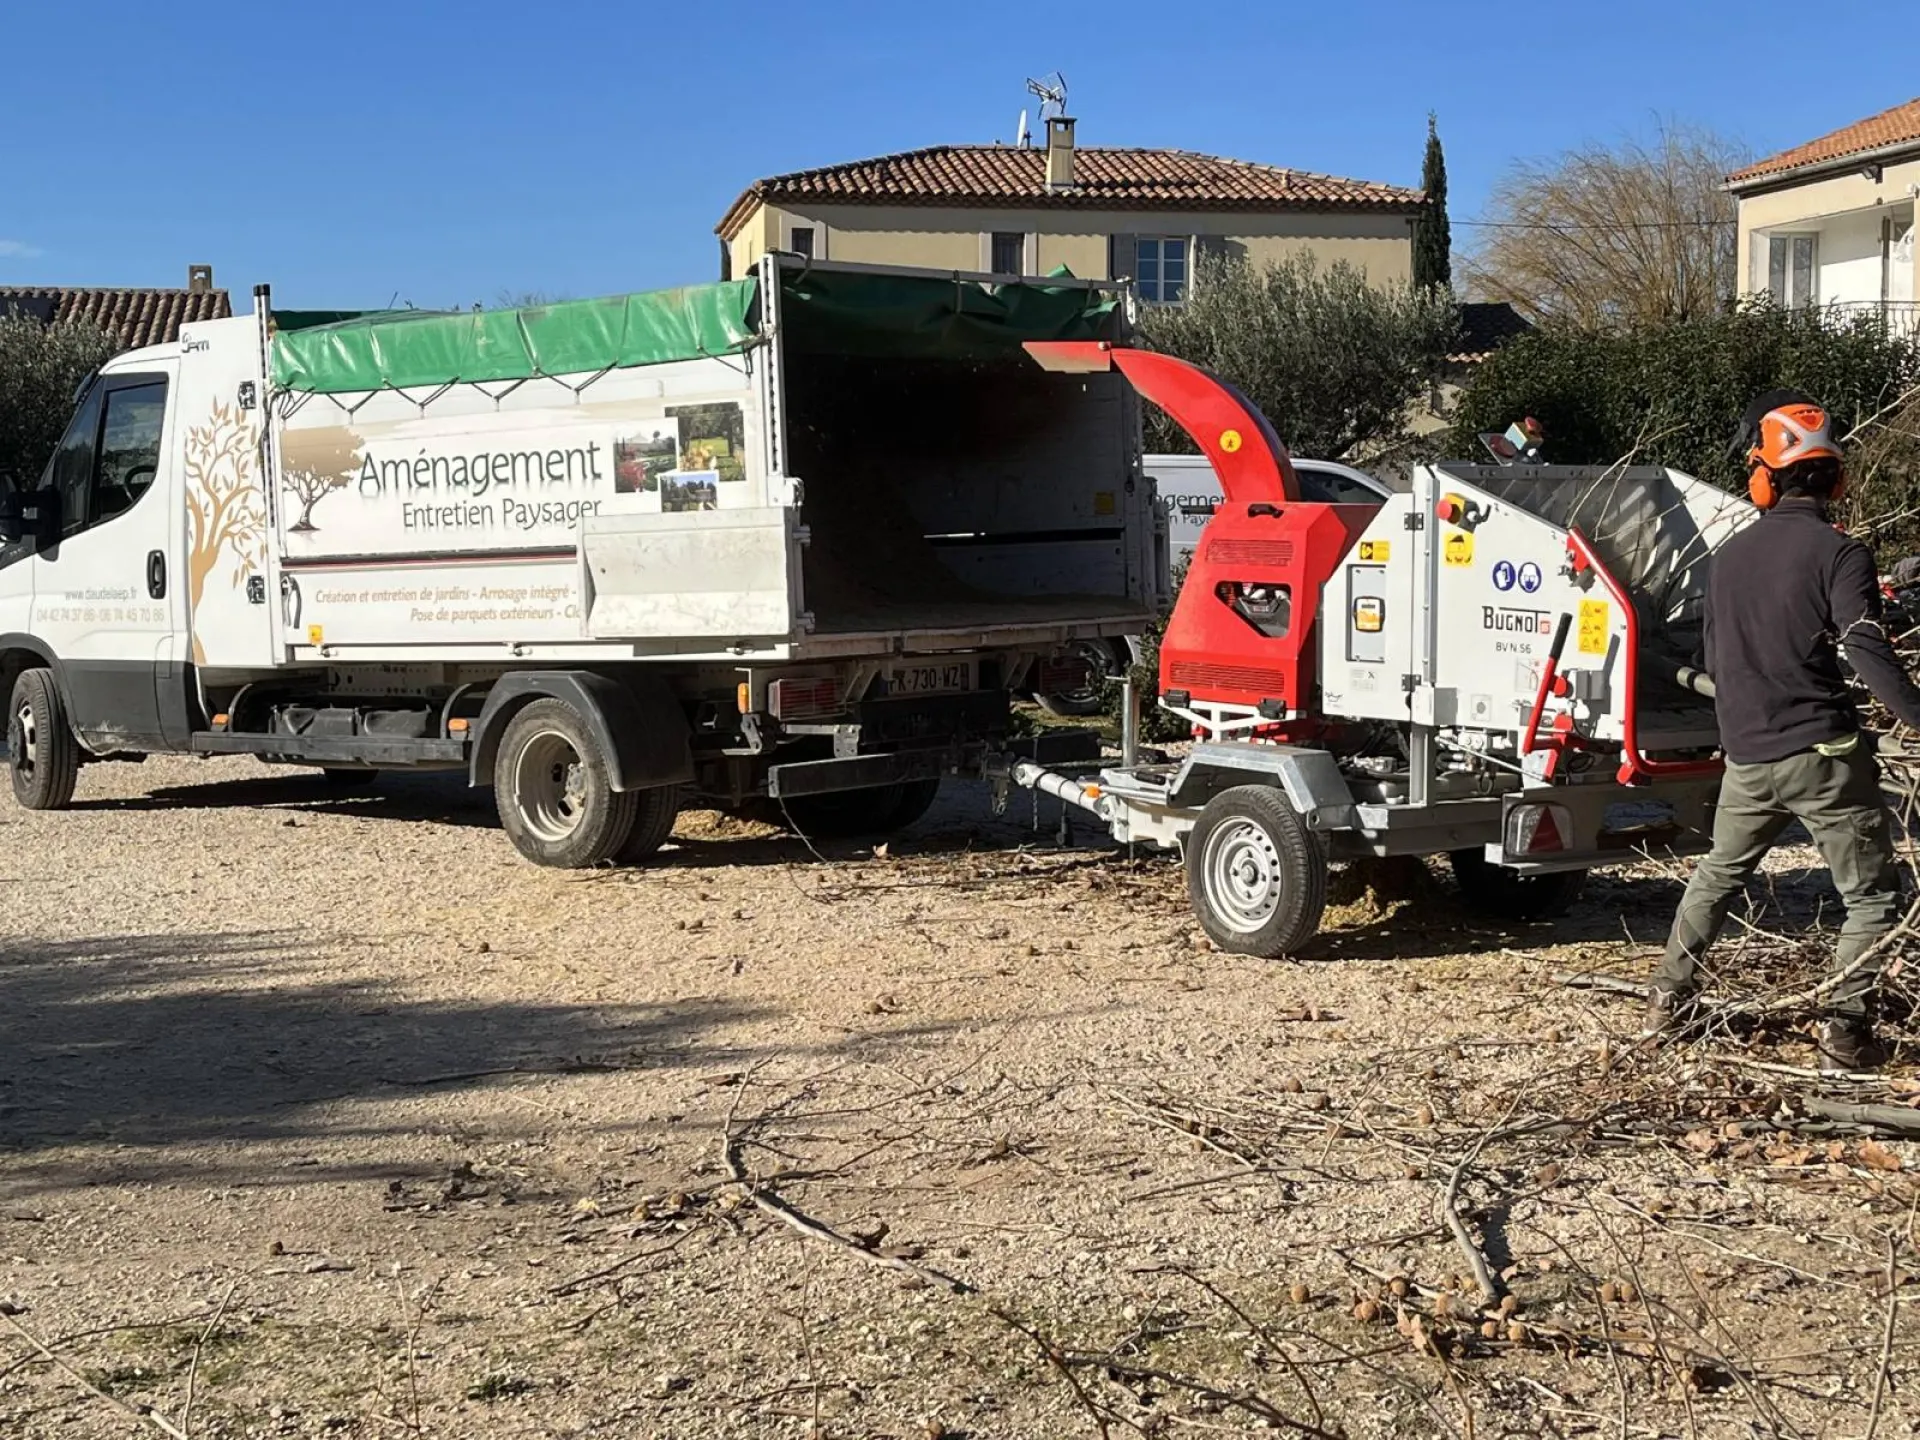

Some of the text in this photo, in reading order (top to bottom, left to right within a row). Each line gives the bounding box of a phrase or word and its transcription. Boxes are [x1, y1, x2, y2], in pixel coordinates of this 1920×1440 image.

[359, 441, 601, 496] Aménagement
[403, 498, 602, 530] Entretien Paysager
[315, 589, 357, 603] Création
[359, 590, 369, 603] et
[372, 589, 418, 602] entretien
[420, 587, 433, 600] de
[434, 587, 469, 604] jardins
[479, 586, 528, 602] Arrosage
[530, 585, 569, 602] intégré
[410, 608, 433, 622] Pose
[436, 607, 449, 620] de
[451, 608, 497, 624] parquets
[500, 605, 553, 620] extérieurs
[1482, 606, 1551, 633] BUGNOT
